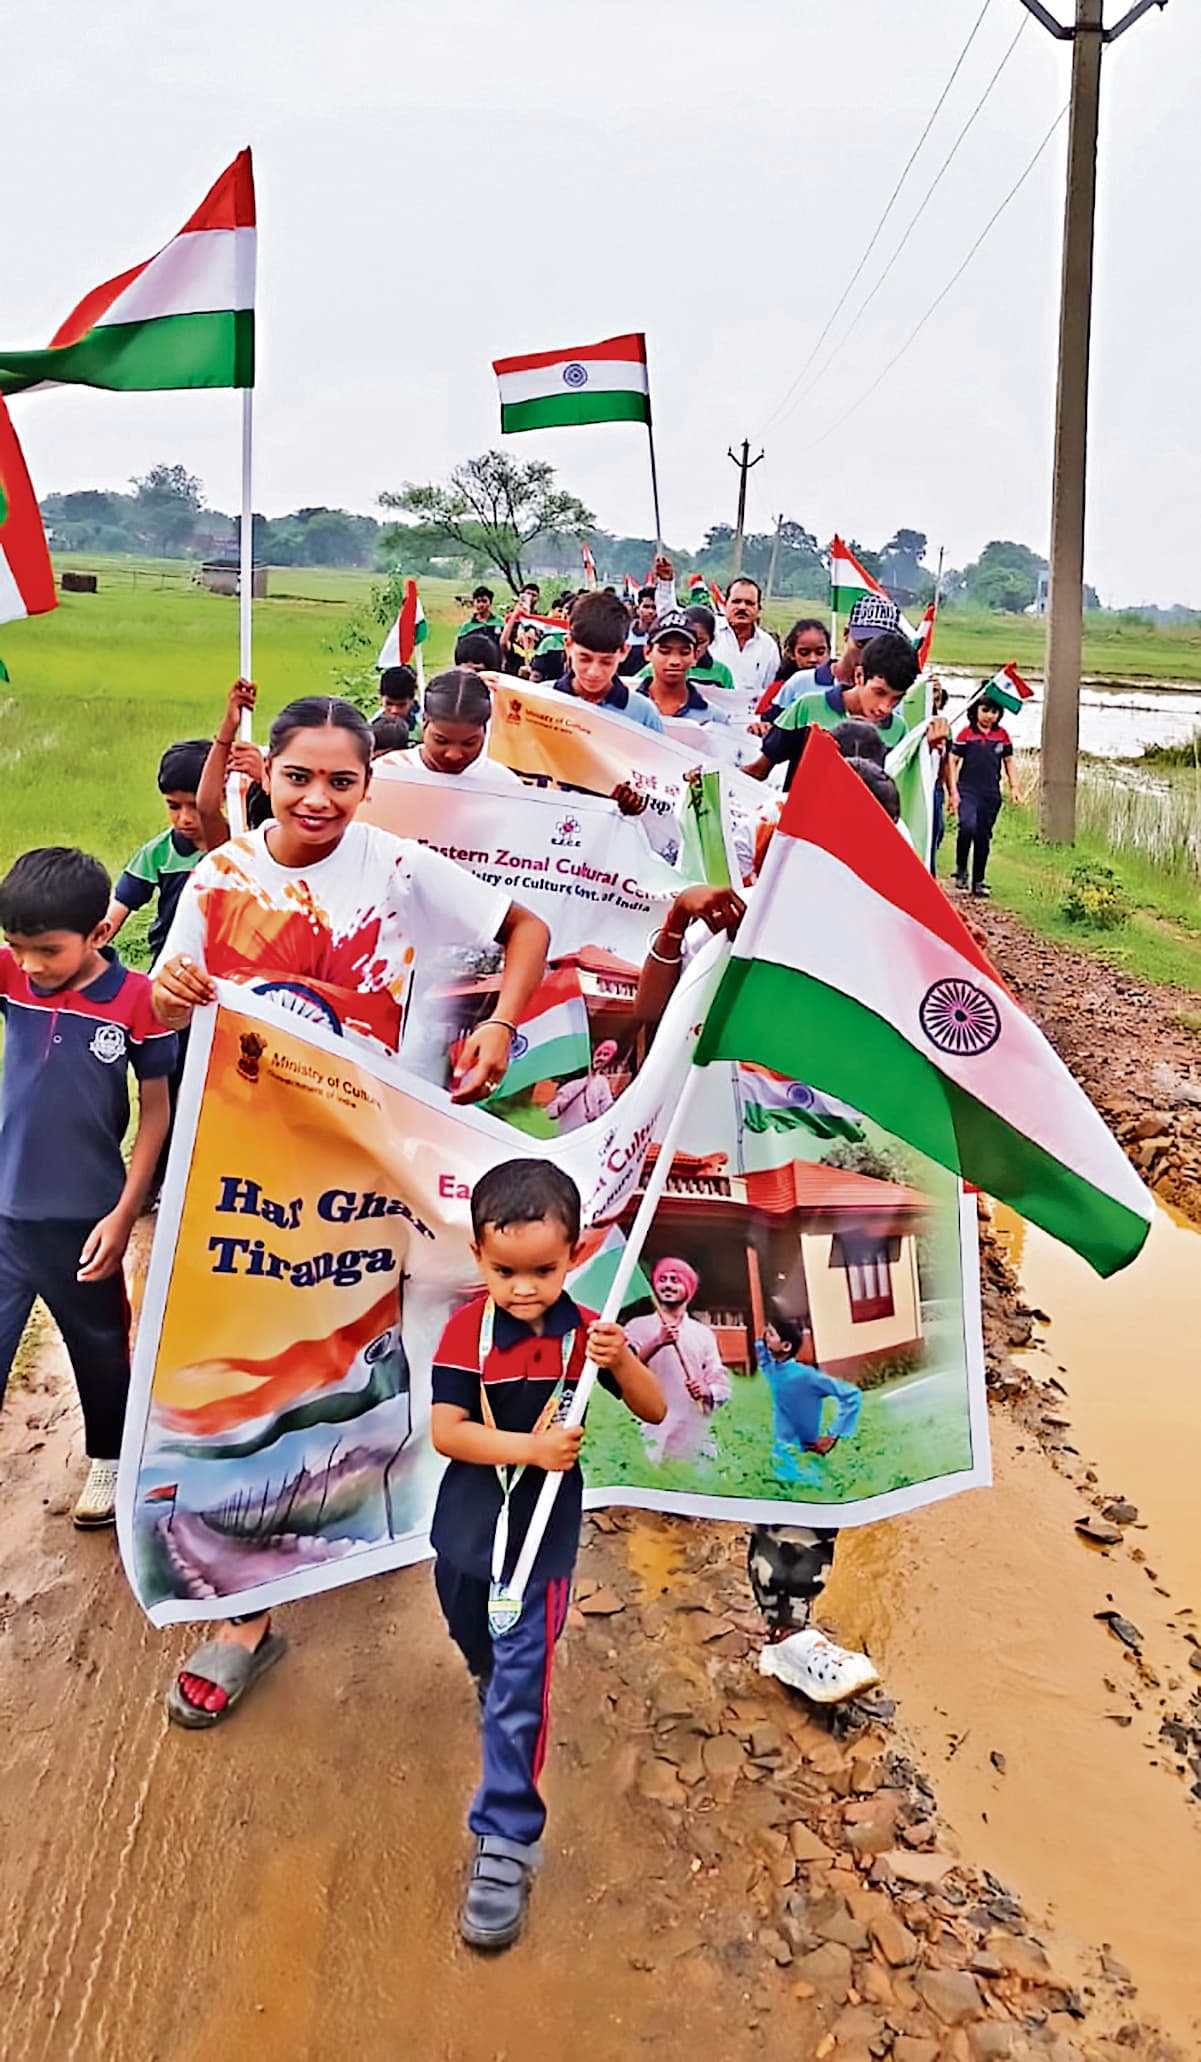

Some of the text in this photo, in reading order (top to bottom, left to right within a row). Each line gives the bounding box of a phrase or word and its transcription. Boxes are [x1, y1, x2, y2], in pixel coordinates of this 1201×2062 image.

[417, 839, 489, 864] stern
[494, 849, 550, 872] Zonal
[504, 875, 520, 887] of
[601, 892, 615, 902] of
[615, 896, 650, 912] India
[270, 1052, 324, 1085] Ministry
[327, 1076, 339, 1089] of
[208, 1236, 396, 1288] Tiranga
